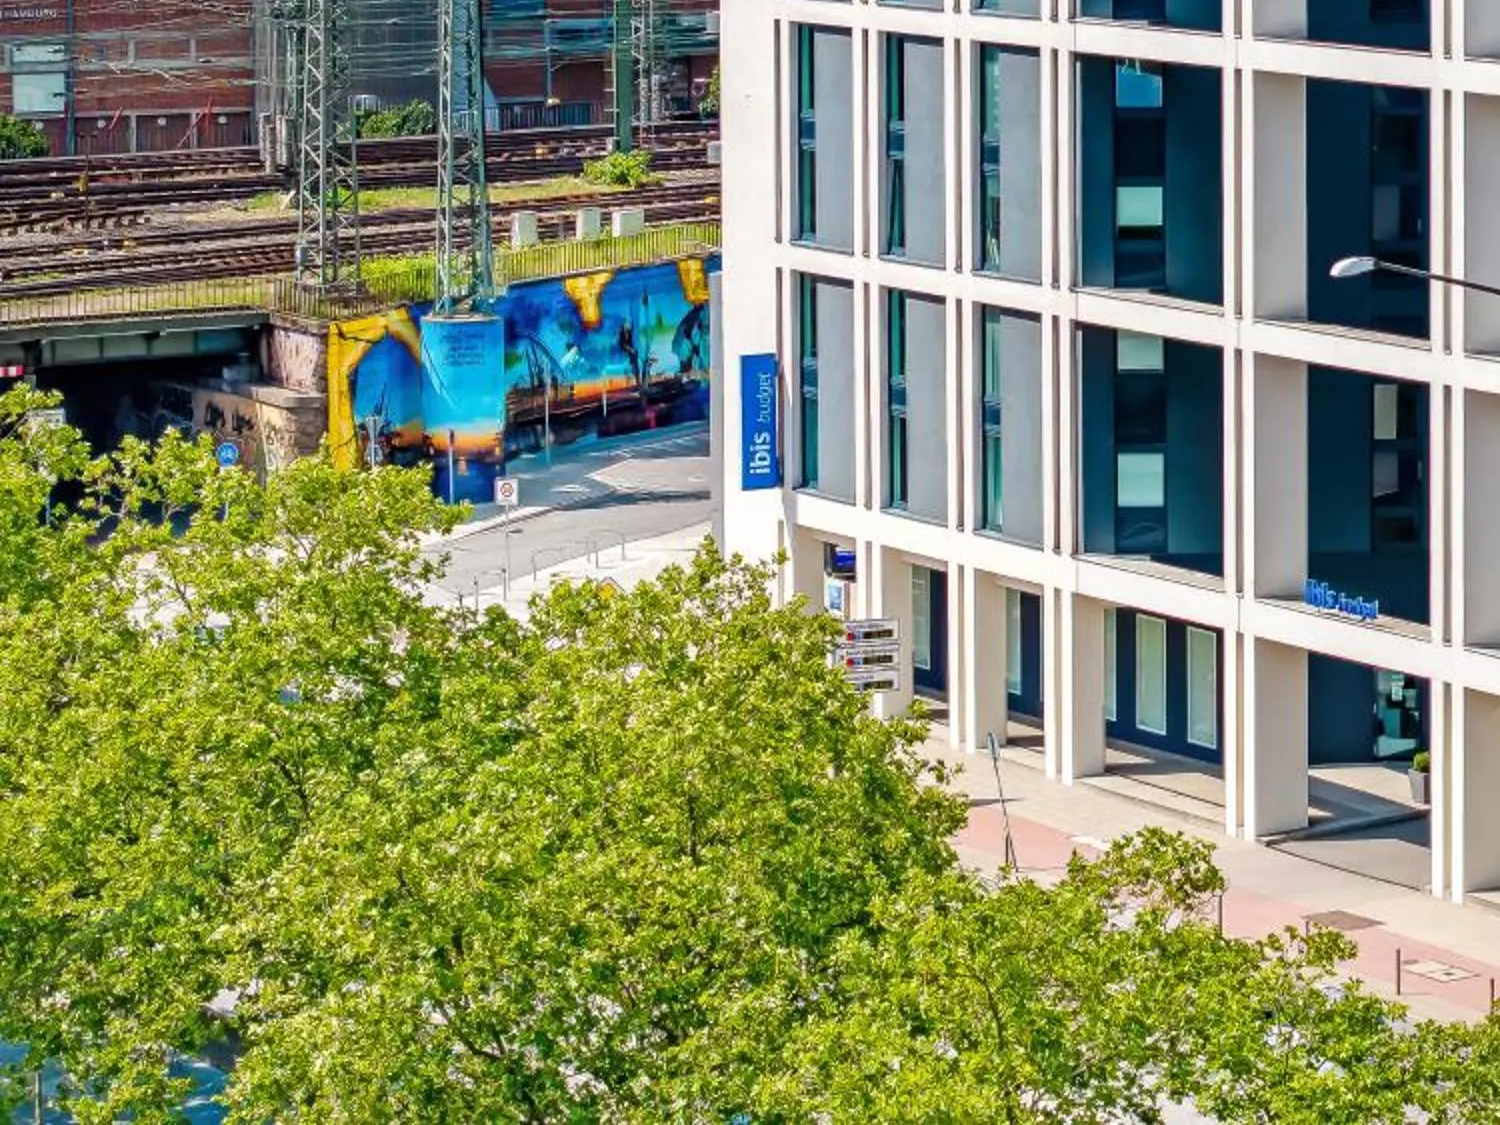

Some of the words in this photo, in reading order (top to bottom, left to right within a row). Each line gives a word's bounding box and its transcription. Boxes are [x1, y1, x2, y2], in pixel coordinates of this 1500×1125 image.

[756, 371, 773, 424] budget
[749, 431, 771, 475] ibis
[1304, 579, 1336, 609] ibis
